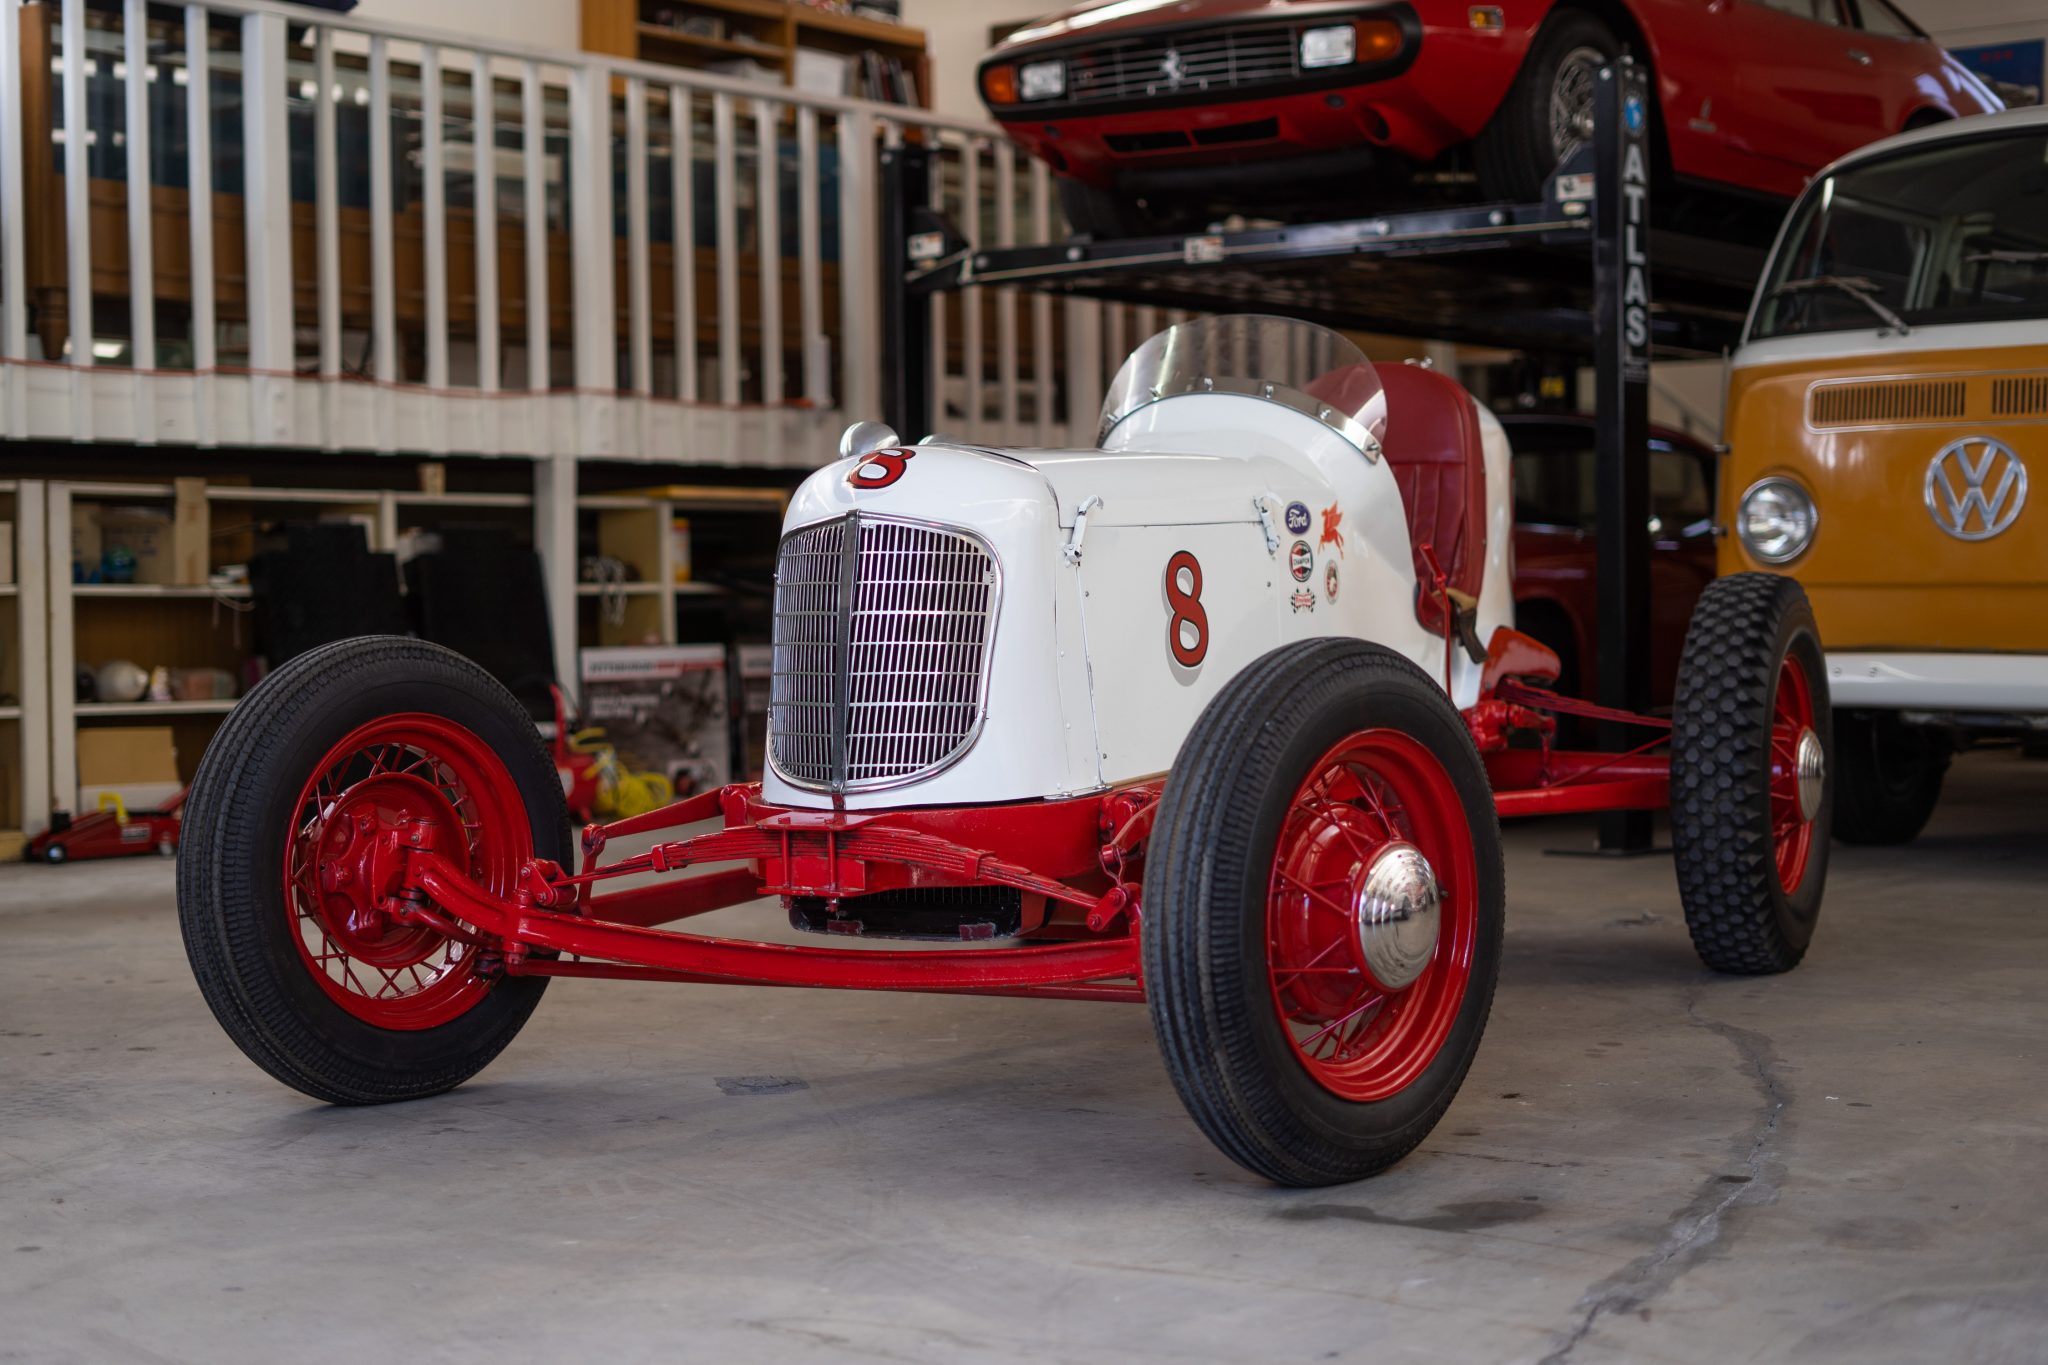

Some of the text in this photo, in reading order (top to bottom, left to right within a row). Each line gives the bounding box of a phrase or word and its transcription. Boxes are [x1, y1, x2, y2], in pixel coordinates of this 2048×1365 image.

[1623, 143, 1647, 347] ATLAS
[847, 448, 916, 489] 8
[1928, 439, 2023, 537] VW
[1288, 508, 1308, 529] Ford
[1165, 549, 1209, 668] 8
